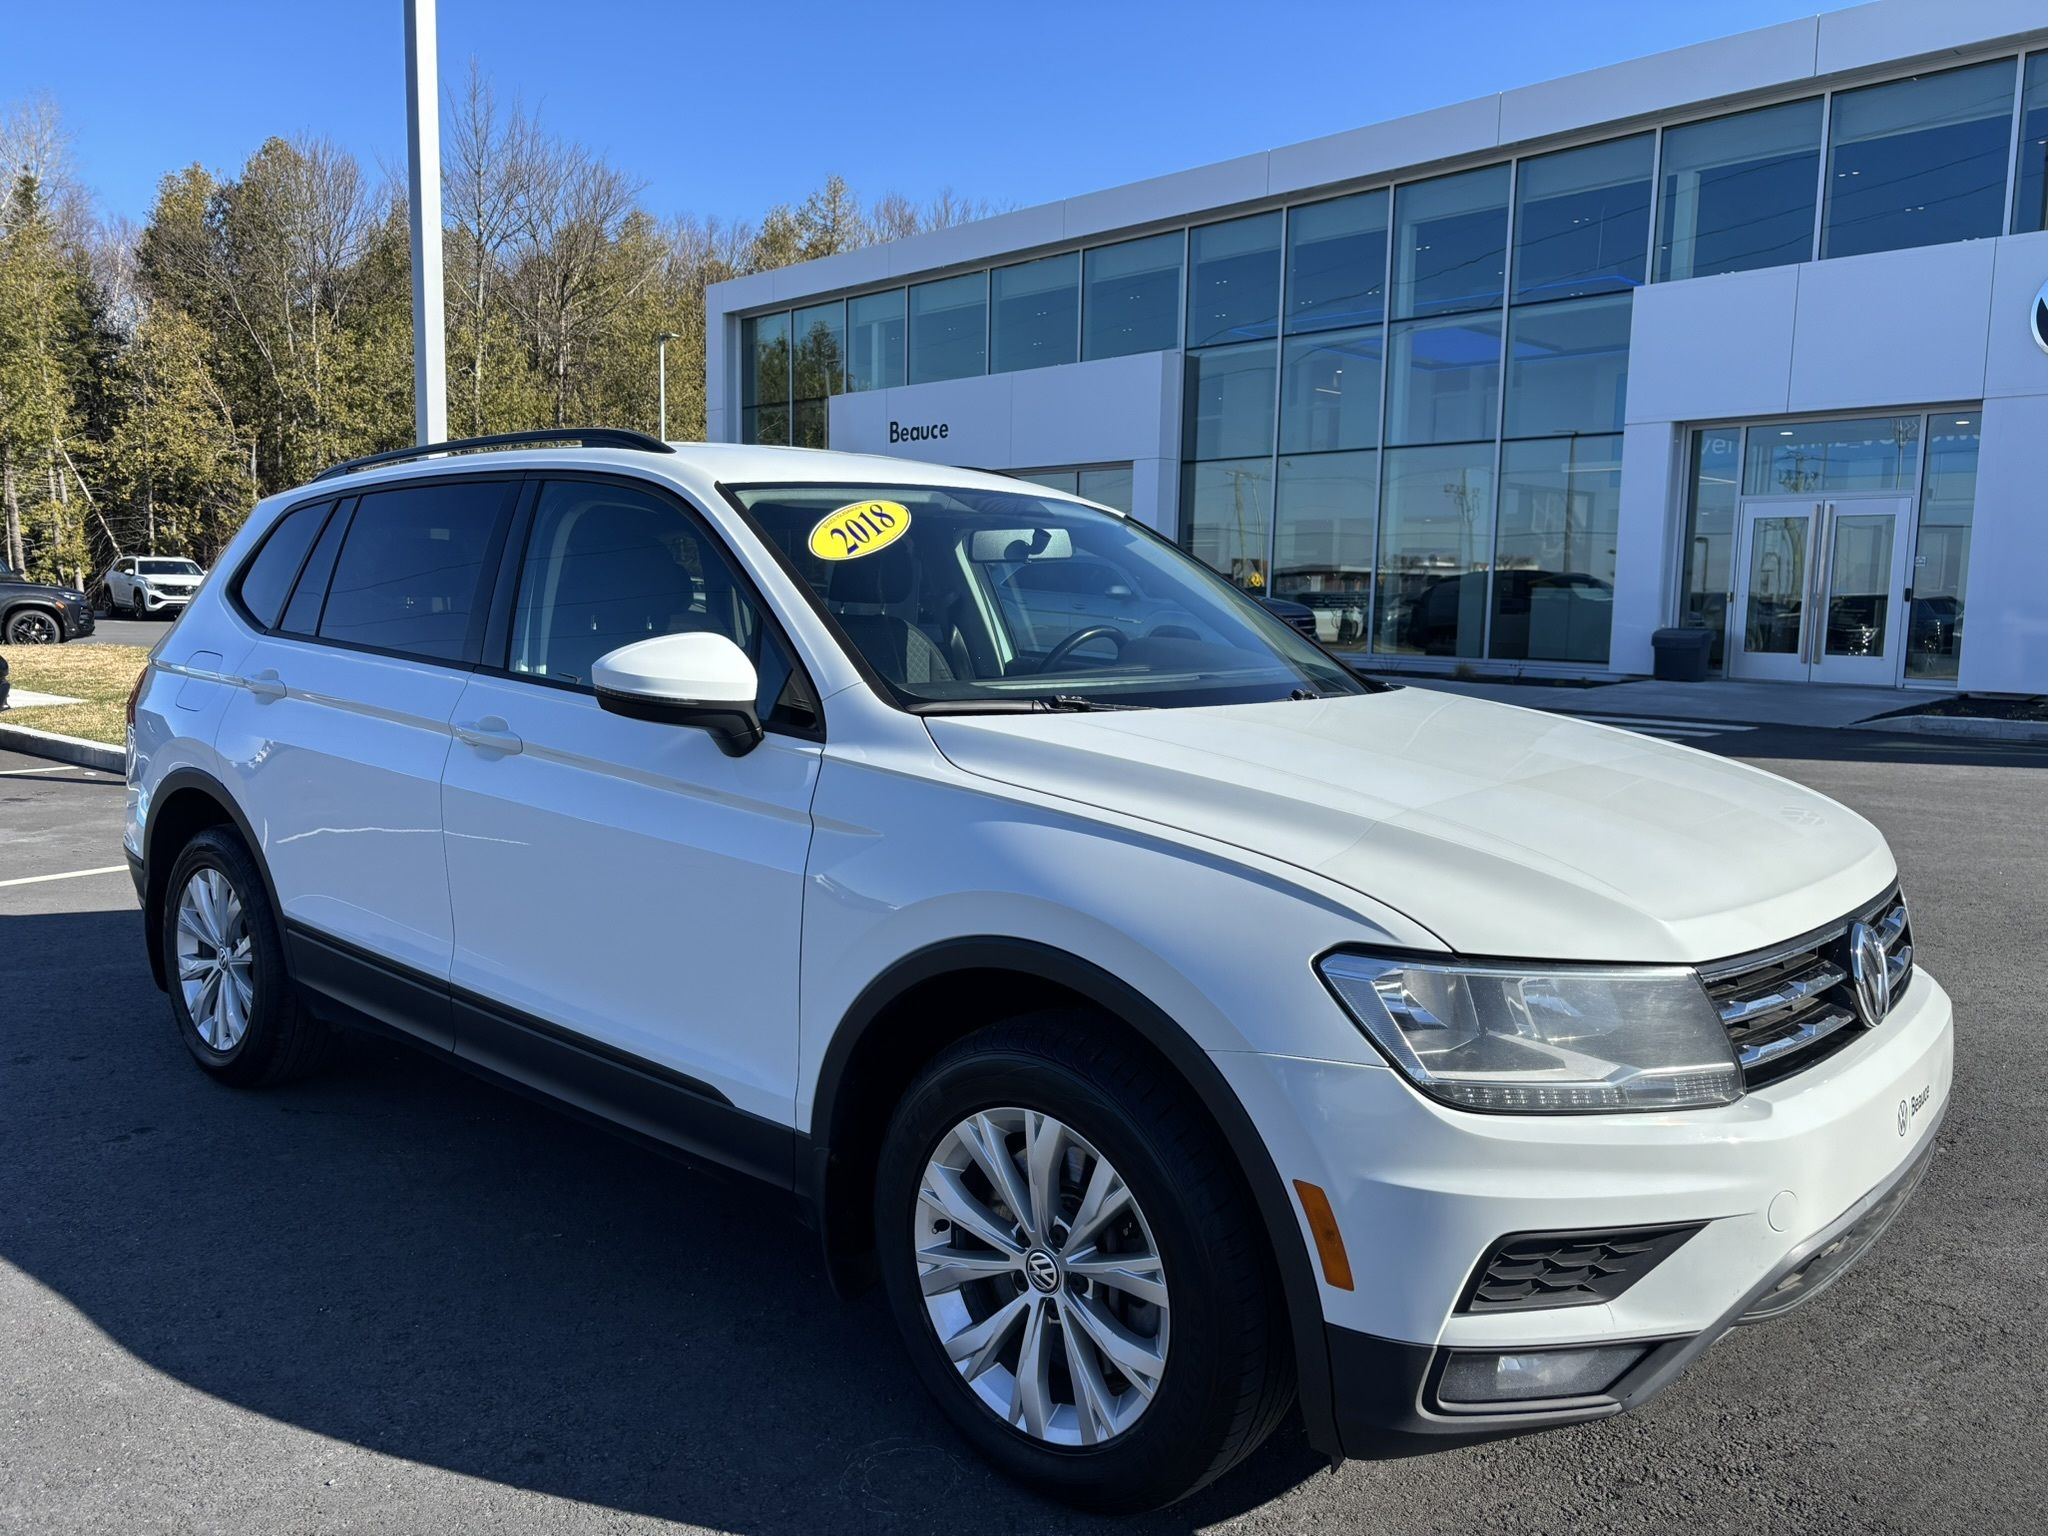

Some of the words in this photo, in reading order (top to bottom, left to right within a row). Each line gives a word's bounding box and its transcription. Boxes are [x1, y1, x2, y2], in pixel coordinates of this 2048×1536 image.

[889, 421, 949, 443] Beauce
[830, 504, 896, 555] 2018
[1911, 1085, 1930, 1117] Beauce
